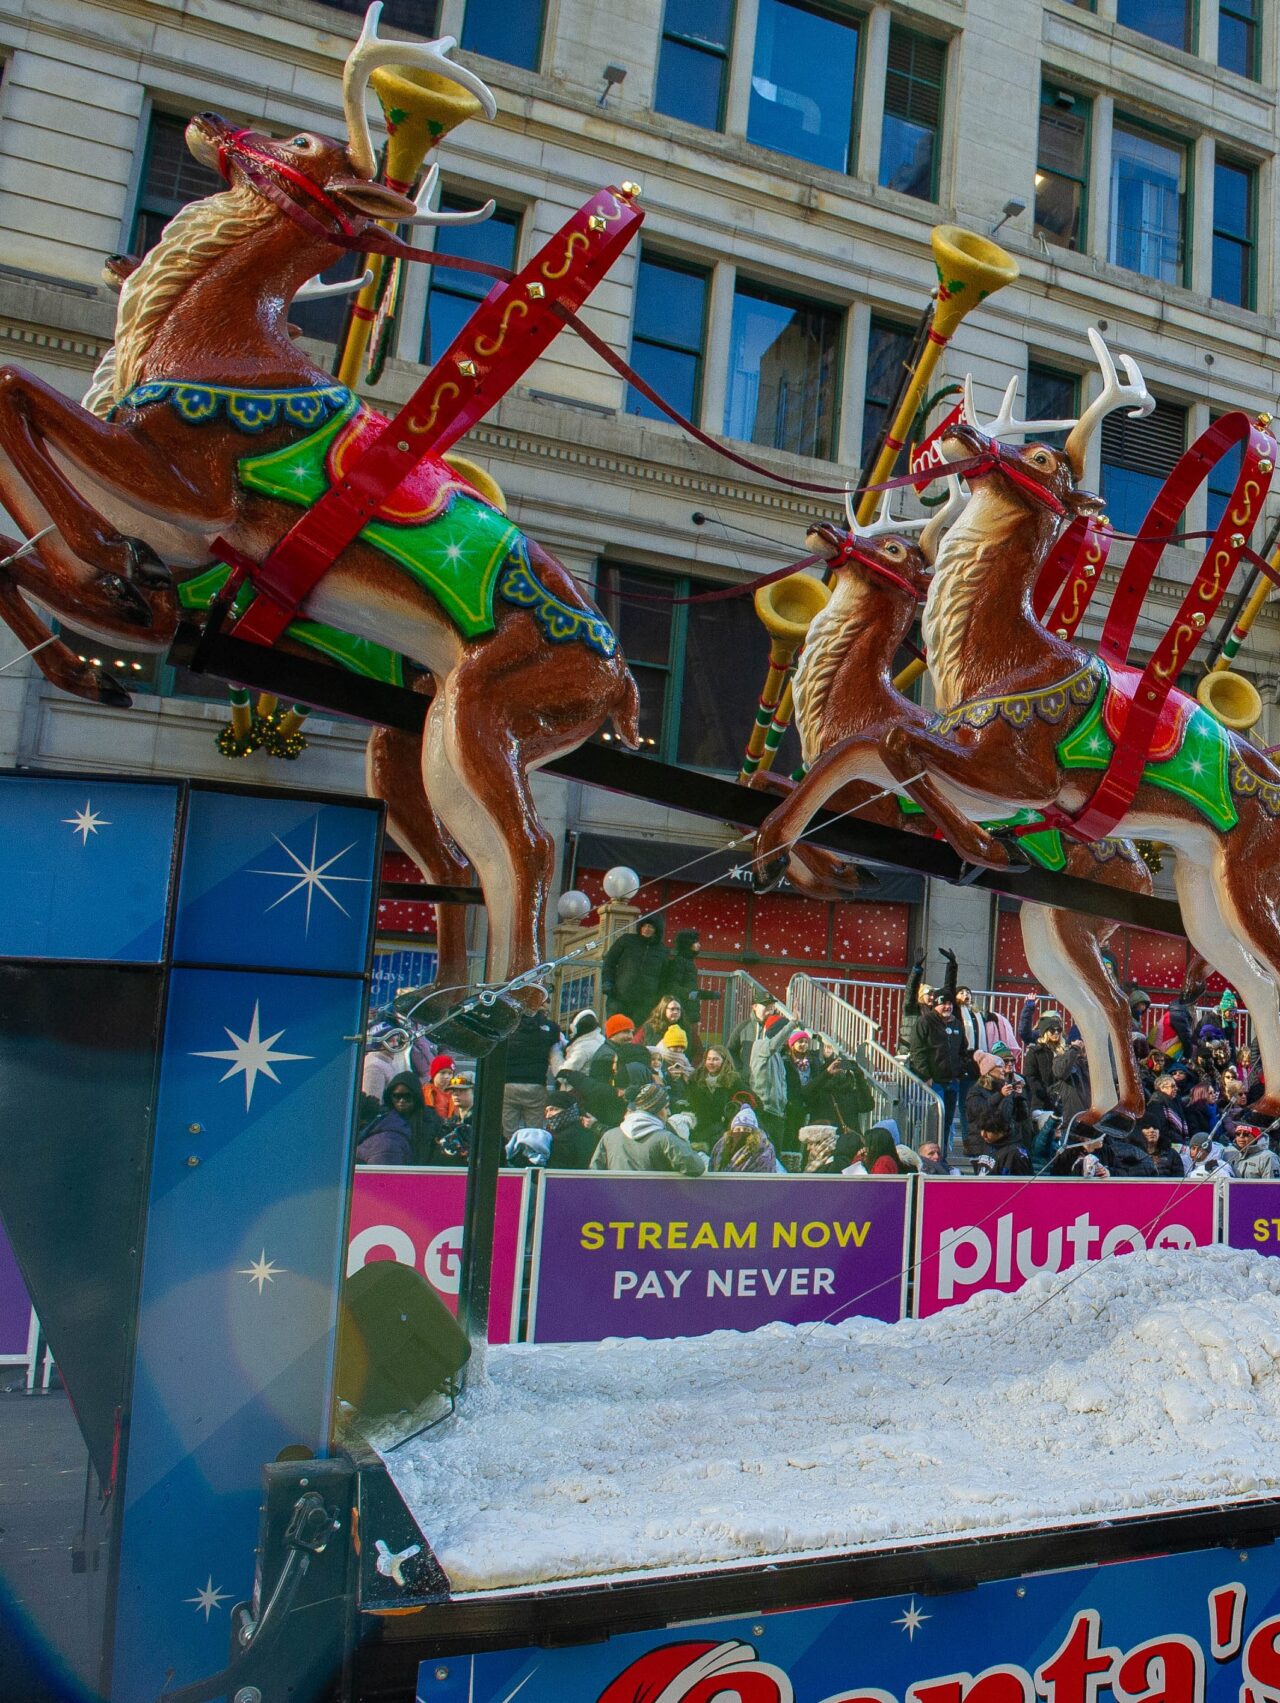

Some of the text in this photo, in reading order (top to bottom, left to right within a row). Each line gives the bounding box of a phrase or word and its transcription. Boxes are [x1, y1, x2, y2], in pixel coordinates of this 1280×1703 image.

[580, 1220, 872, 1250] STREAM NOW
[613, 1267, 836, 1300] PAY NEVER
